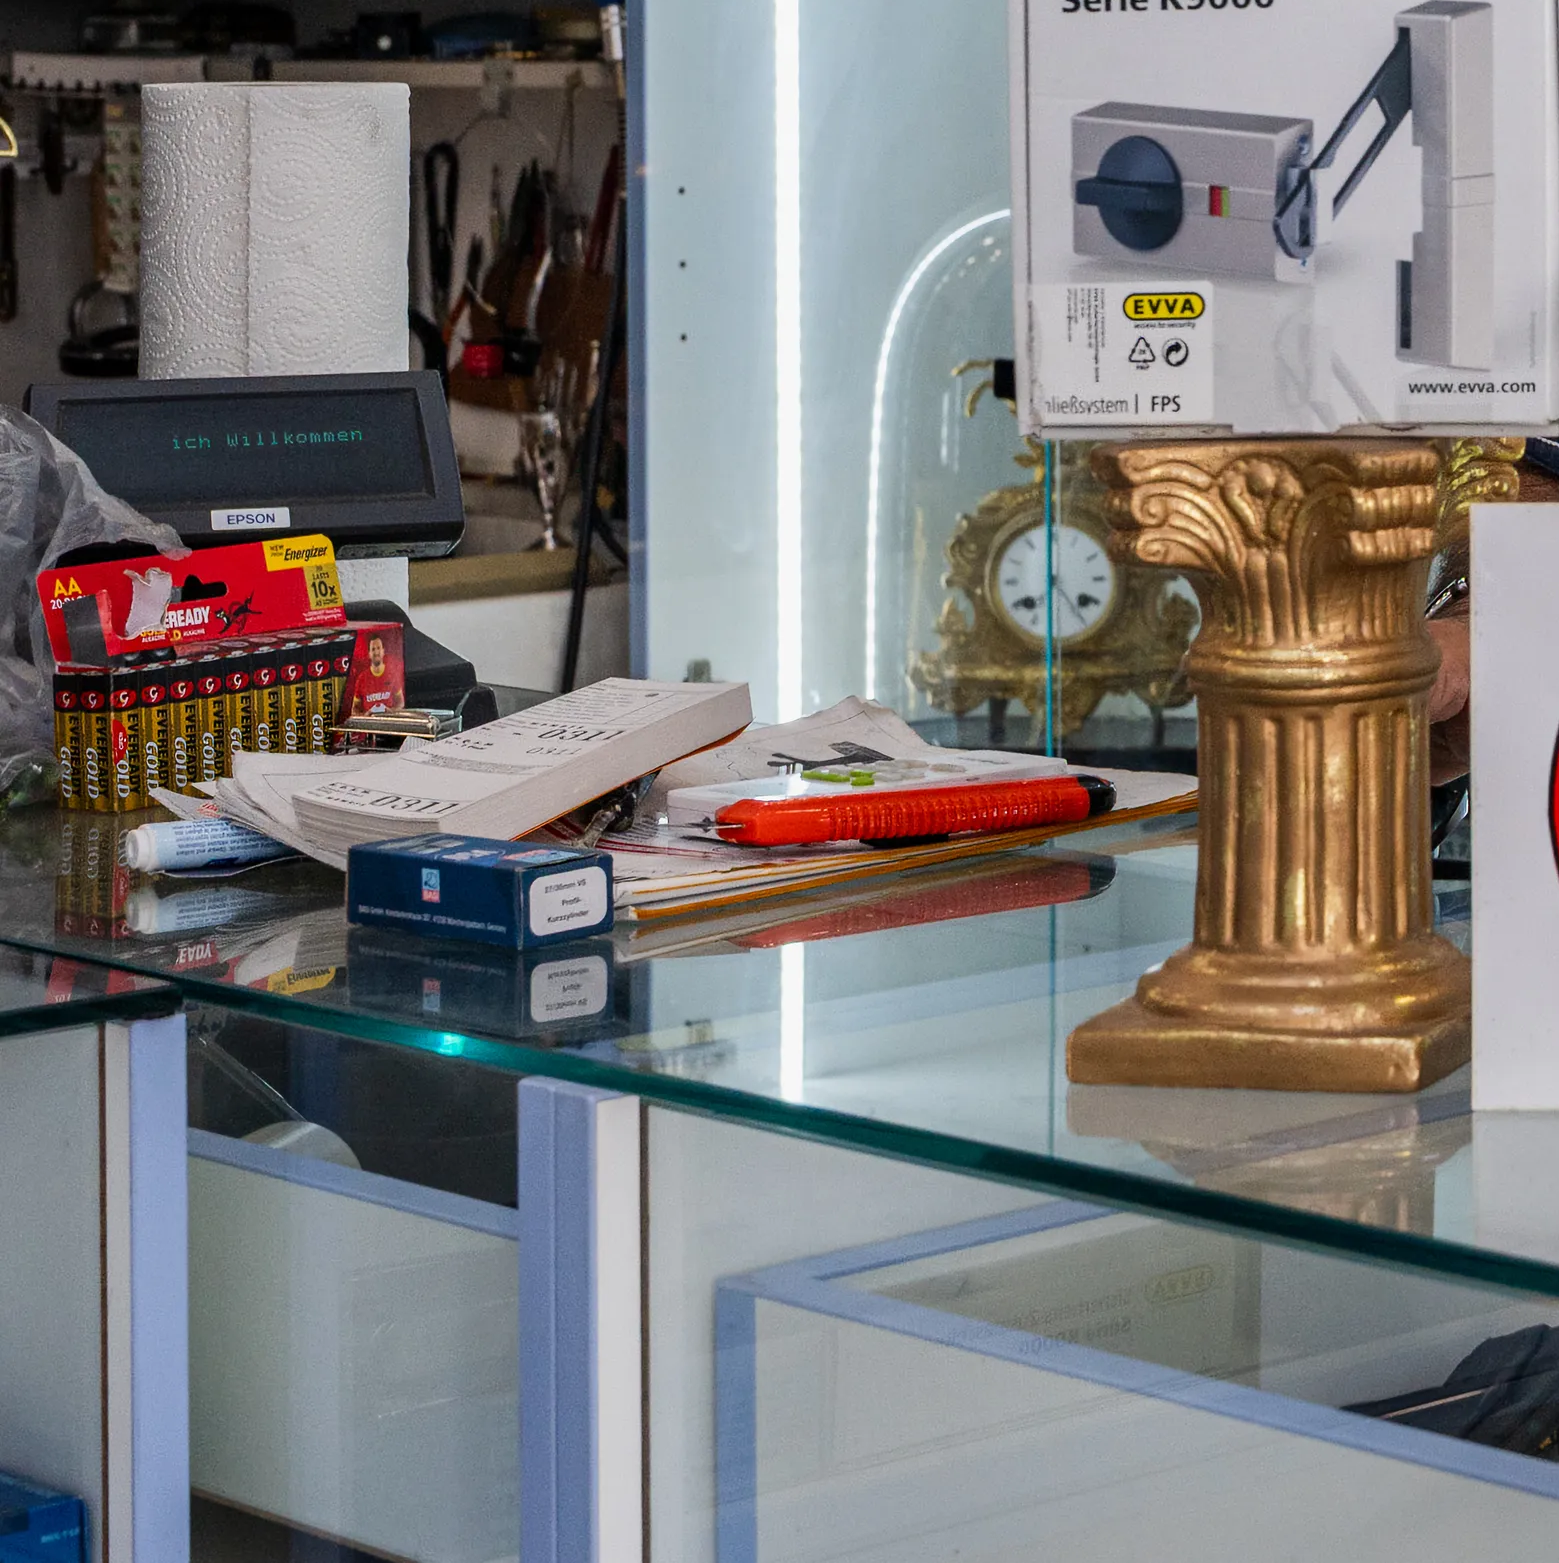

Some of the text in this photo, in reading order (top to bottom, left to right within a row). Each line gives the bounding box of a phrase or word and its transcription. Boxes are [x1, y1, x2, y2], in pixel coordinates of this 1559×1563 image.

[1133, 297, 1195, 315] EVVA
[1151, 394, 1182, 414] FPS
[1408, 379, 1537, 395] www.evva.com
[172, 429, 364, 450] ich Willkommen
[226, 513, 276, 526] EPSON
[283, 544, 328, 561] Energizer
[53, 577, 83, 598] AA
[310, 580, 338, 599] 10x
[68, 716, 81, 798] EVEREADY
[95, 716, 109, 799] EVEREADY
[127, 713, 141, 796] EVEREADY
[145, 741, 160, 790] GOLD
[156, 708, 169, 791] EVEREADY
[173, 736, 187, 788] GOLD
[184, 704, 198, 784] EVEREADY
[201, 732, 216, 783] GOLD
[59, 746, 74, 799] GOLD
[85, 748, 101, 800] GOLD
[115, 749, 130, 798] OLD
[546, 908, 590, 924] Kurzzylinder
